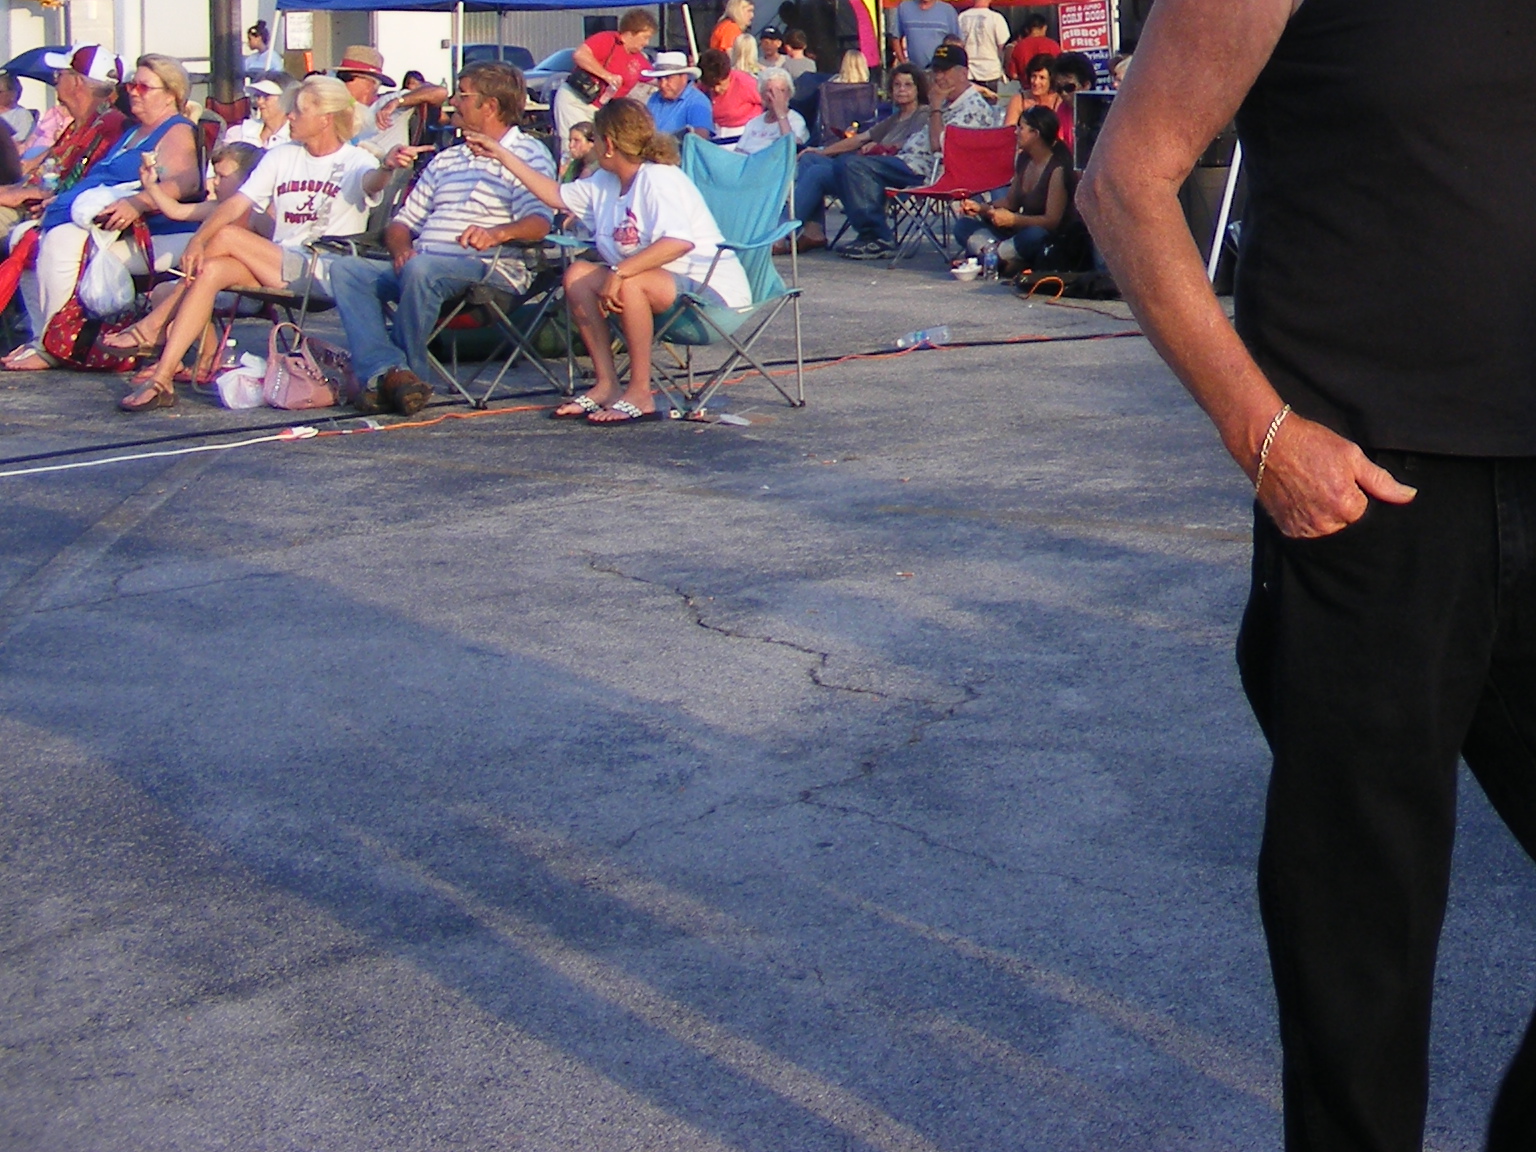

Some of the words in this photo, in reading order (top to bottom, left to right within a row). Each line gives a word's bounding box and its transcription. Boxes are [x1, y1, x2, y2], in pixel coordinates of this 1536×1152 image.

[1084, 9, 1106, 22] DOGS
[1062, 25, 1107, 41] RIBBON
[1070, 37, 1102, 47] FRIES
